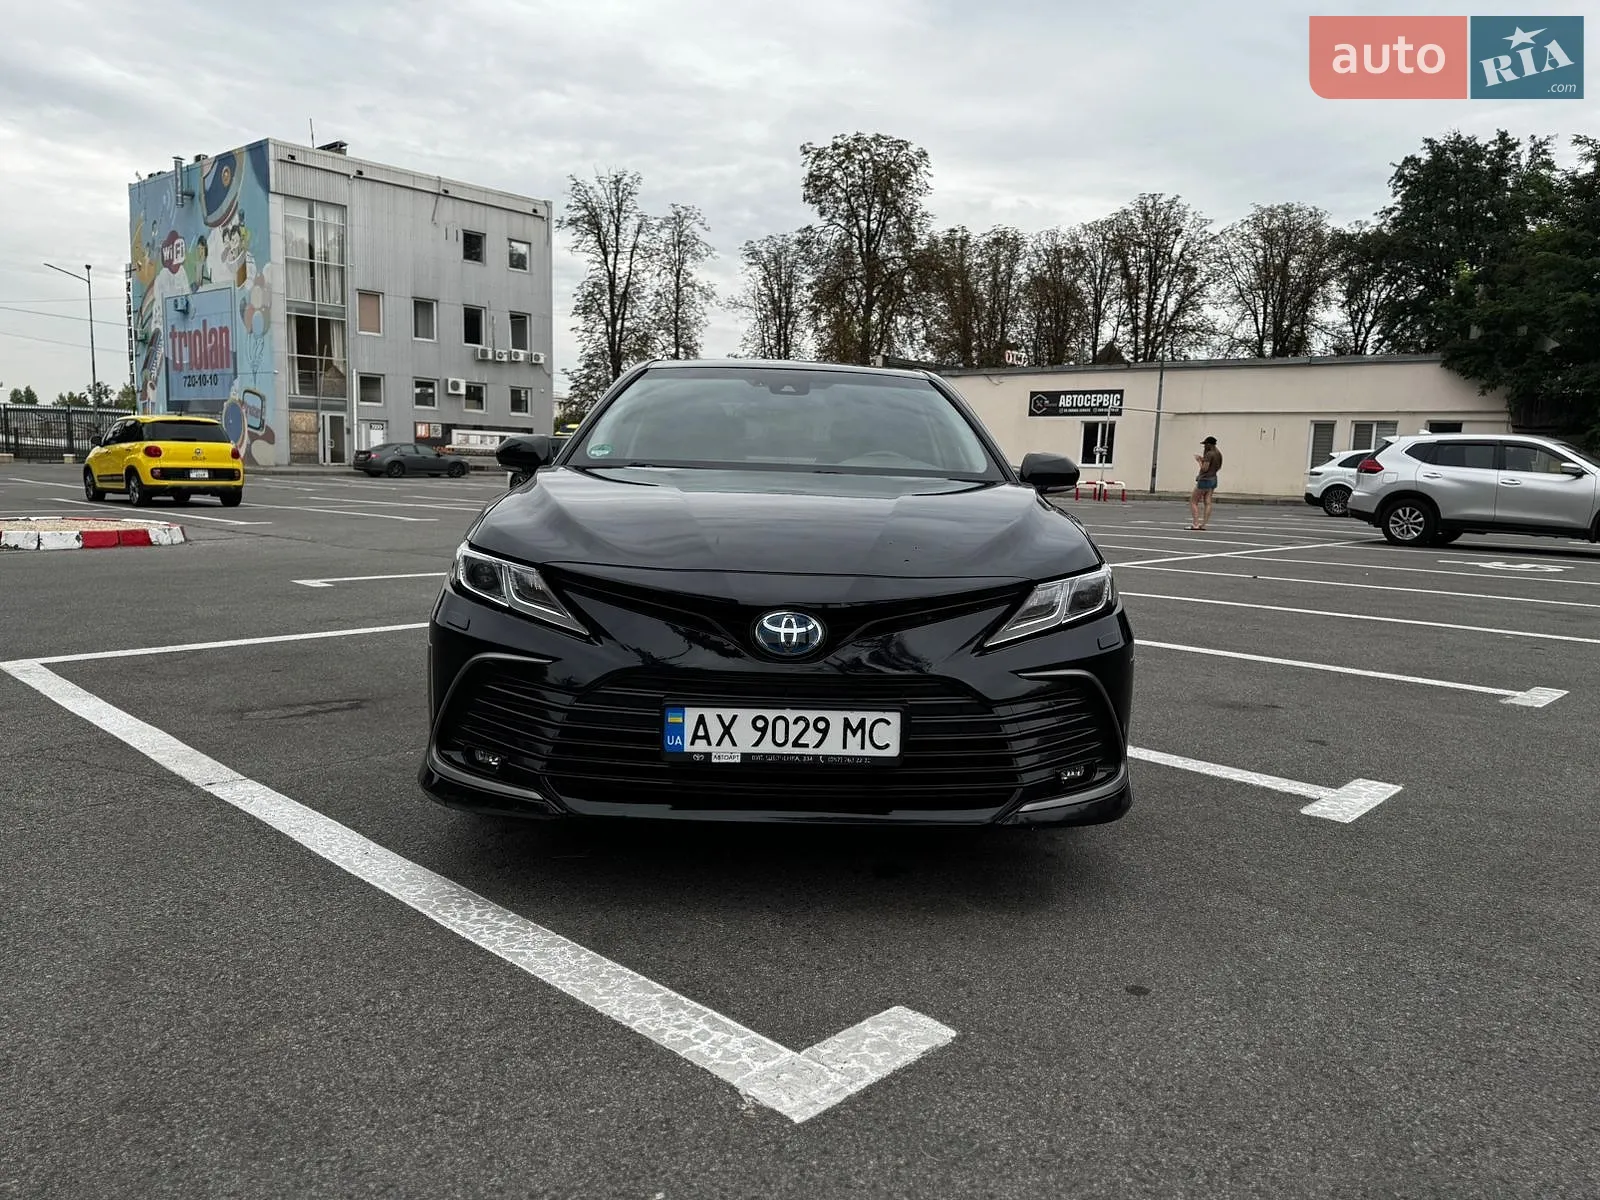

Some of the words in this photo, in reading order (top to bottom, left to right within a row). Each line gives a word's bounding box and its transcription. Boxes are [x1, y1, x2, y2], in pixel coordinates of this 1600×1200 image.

[169, 320, 231, 372] triolan
[183, 374, 218, 388] 720-10-10
[1059, 393, 1121, 407] АВТОСЕРВІС
[689, 713, 739, 747] AX
[751, 715, 831, 749] 9029
[842, 717, 892, 751] MC
[667, 735, 682, 746] UA
